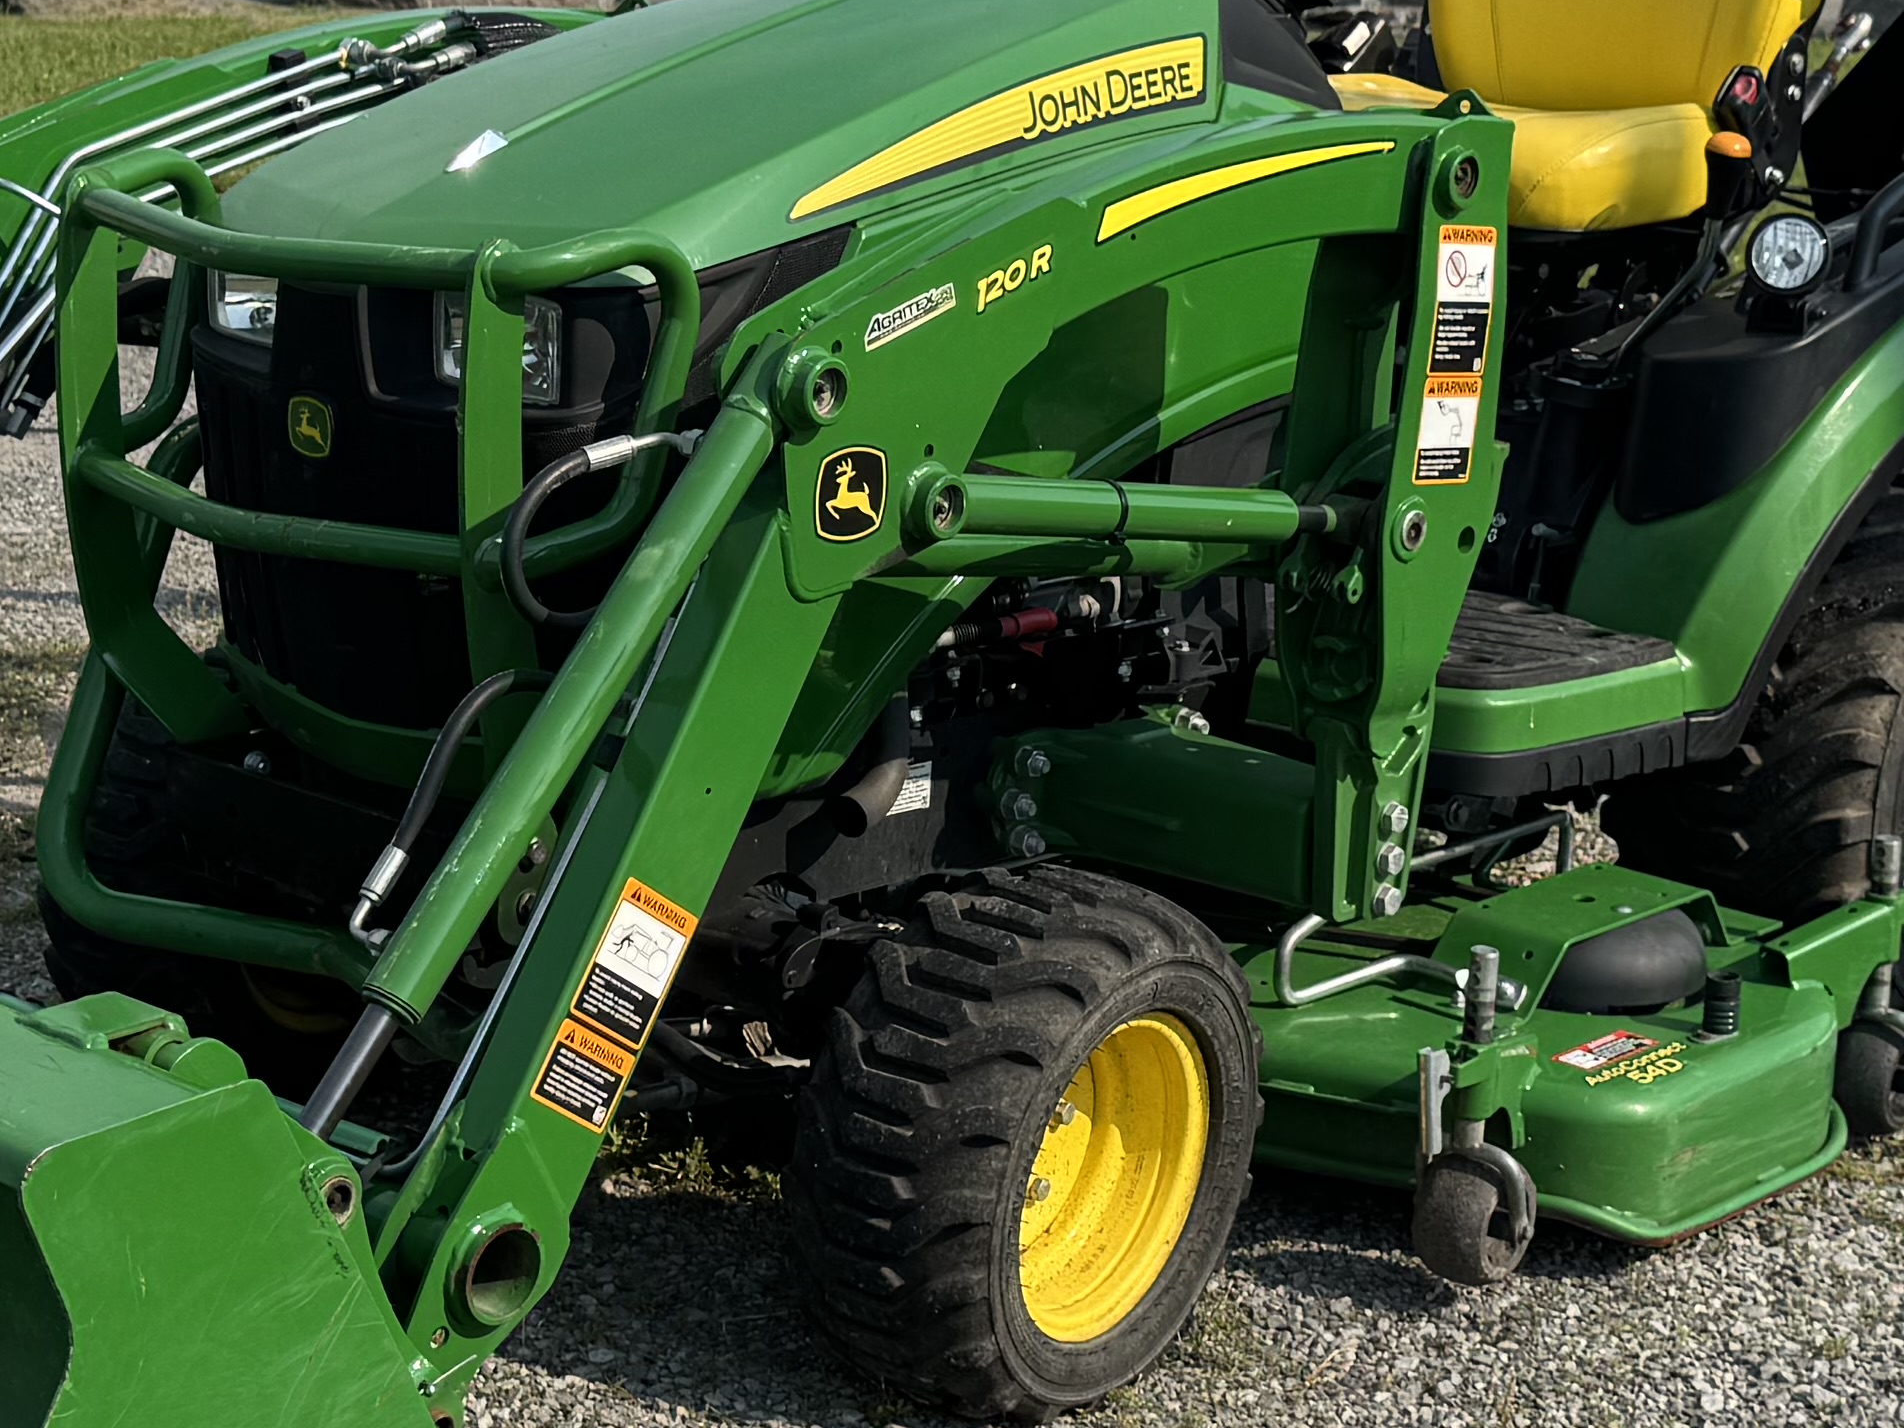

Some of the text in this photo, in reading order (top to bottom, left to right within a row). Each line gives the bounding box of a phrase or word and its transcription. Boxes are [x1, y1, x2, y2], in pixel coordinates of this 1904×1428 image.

[1023, 61, 1194, 134] JOHN DEERE
[1451, 228, 1494, 243] WARNING
[867, 292, 936, 338] AGRITEX
[1436, 380, 1478, 395] WARNING
[642, 893, 686, 930] WARNING
[578, 1034, 624, 1070] WARNING
[1585, 1041, 1687, 1087] AutoConnect
[1626, 1058, 1684, 1085] 54D
